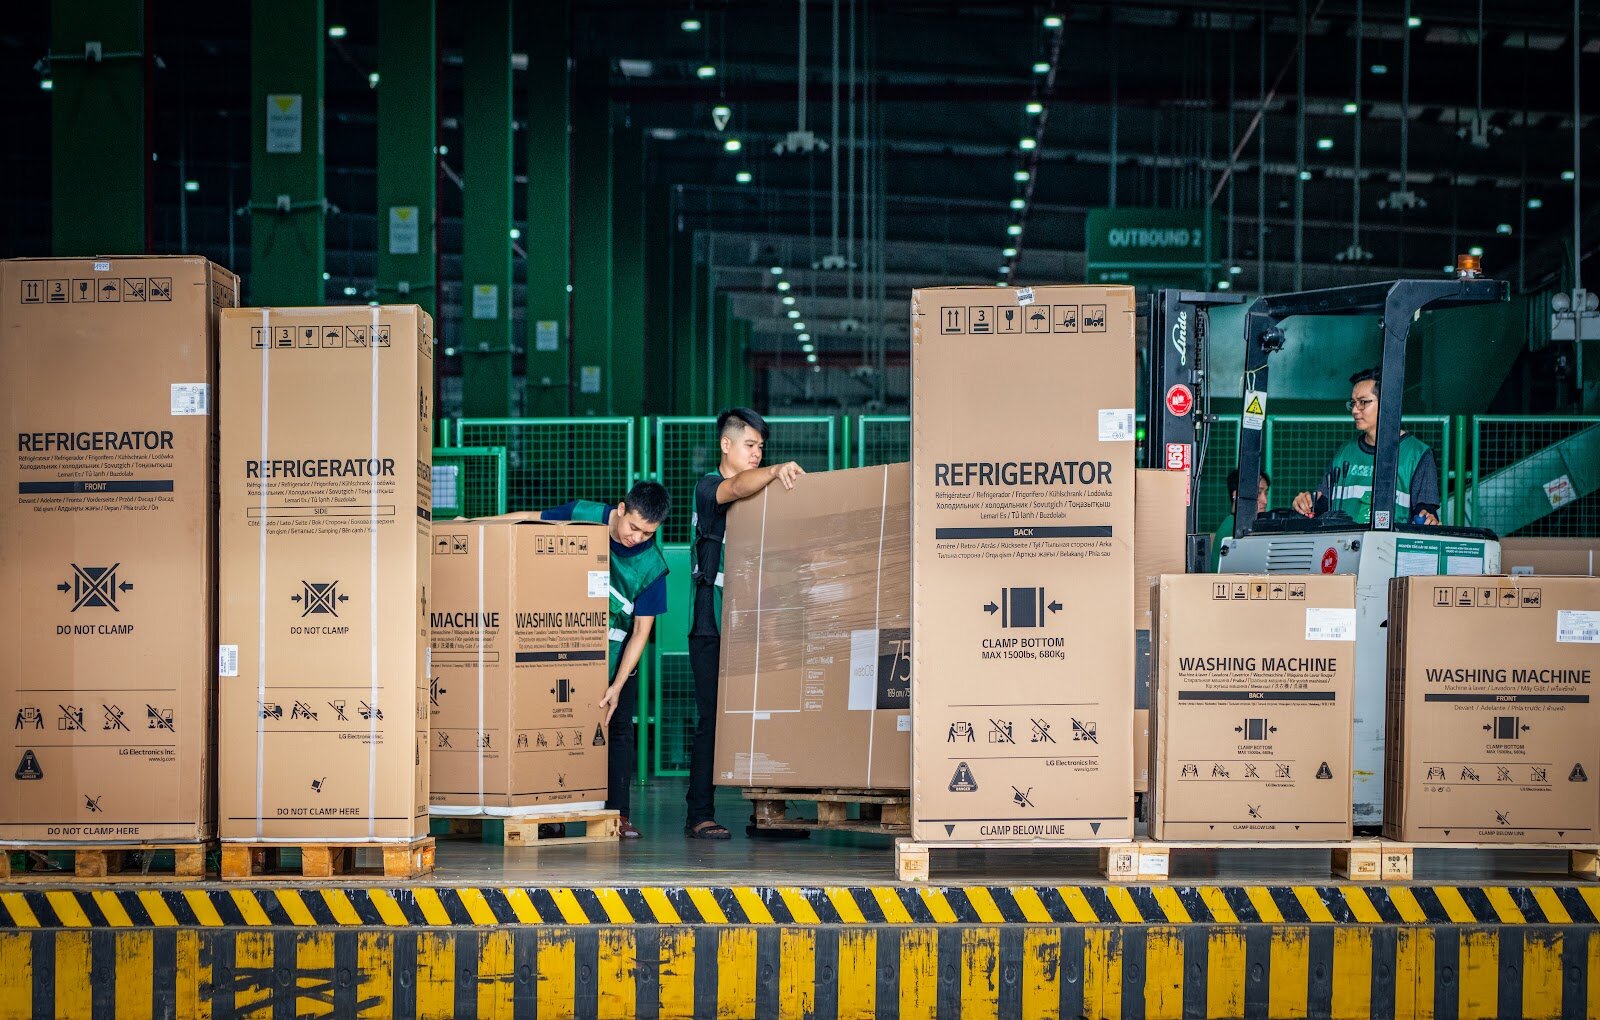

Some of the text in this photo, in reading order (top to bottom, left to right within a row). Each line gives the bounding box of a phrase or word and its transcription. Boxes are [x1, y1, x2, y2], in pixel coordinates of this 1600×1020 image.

[1108, 228, 1202, 247] OUTBOUND 2
[55, 282, 61, 292] 3
[978, 310, 985, 321] 3
[282, 329, 289, 338] 3
[1172, 311, 1187, 366] Linde
[18, 430, 174, 451] REFRIGERATOR
[1168, 445, 1184, 469] 058
[246, 458, 395, 478] REFRIGERATOR
[935, 461, 1112, 486] REFRIGERATOR
[84, 482, 107, 490] FRONT
[936, 491, 971, 500] Réfrigérateur
[976, 491, 1011, 499] Refrigerador
[1015, 490, 1045, 499] Frigorifero
[936, 502, 980, 510] Холодильник
[1033, 500, 1063, 509] Sovutgich
[1013, 528, 1034, 536] BACK
[1462, 590, 1468, 598] 4
[431, 612, 500, 628] MACHINE
[515, 611, 606, 628] WASHING MACHINE
[56, 624, 134, 635] DO NOT CLAMP
[304, 626, 320, 634] NOT
[322, 626, 349, 634] CLAMP
[982, 637, 1064, 648] CLAMP BOTTOM
[982, 650, 1065, 660] MAX 1500lbs, 680Kg
[1179, 657, 1336, 672] WASHING MACHINE
[1426, 668, 1591, 684] WASHING MACHINE
[277, 808, 289, 816] DO
[339, 807, 360, 815] HERE
[47, 827, 60, 835] DO
[62, 827, 81, 835] NOT
[83, 827, 114, 835] CLAMP
[980, 824, 1065, 836] CLAMP BELOW LINE
